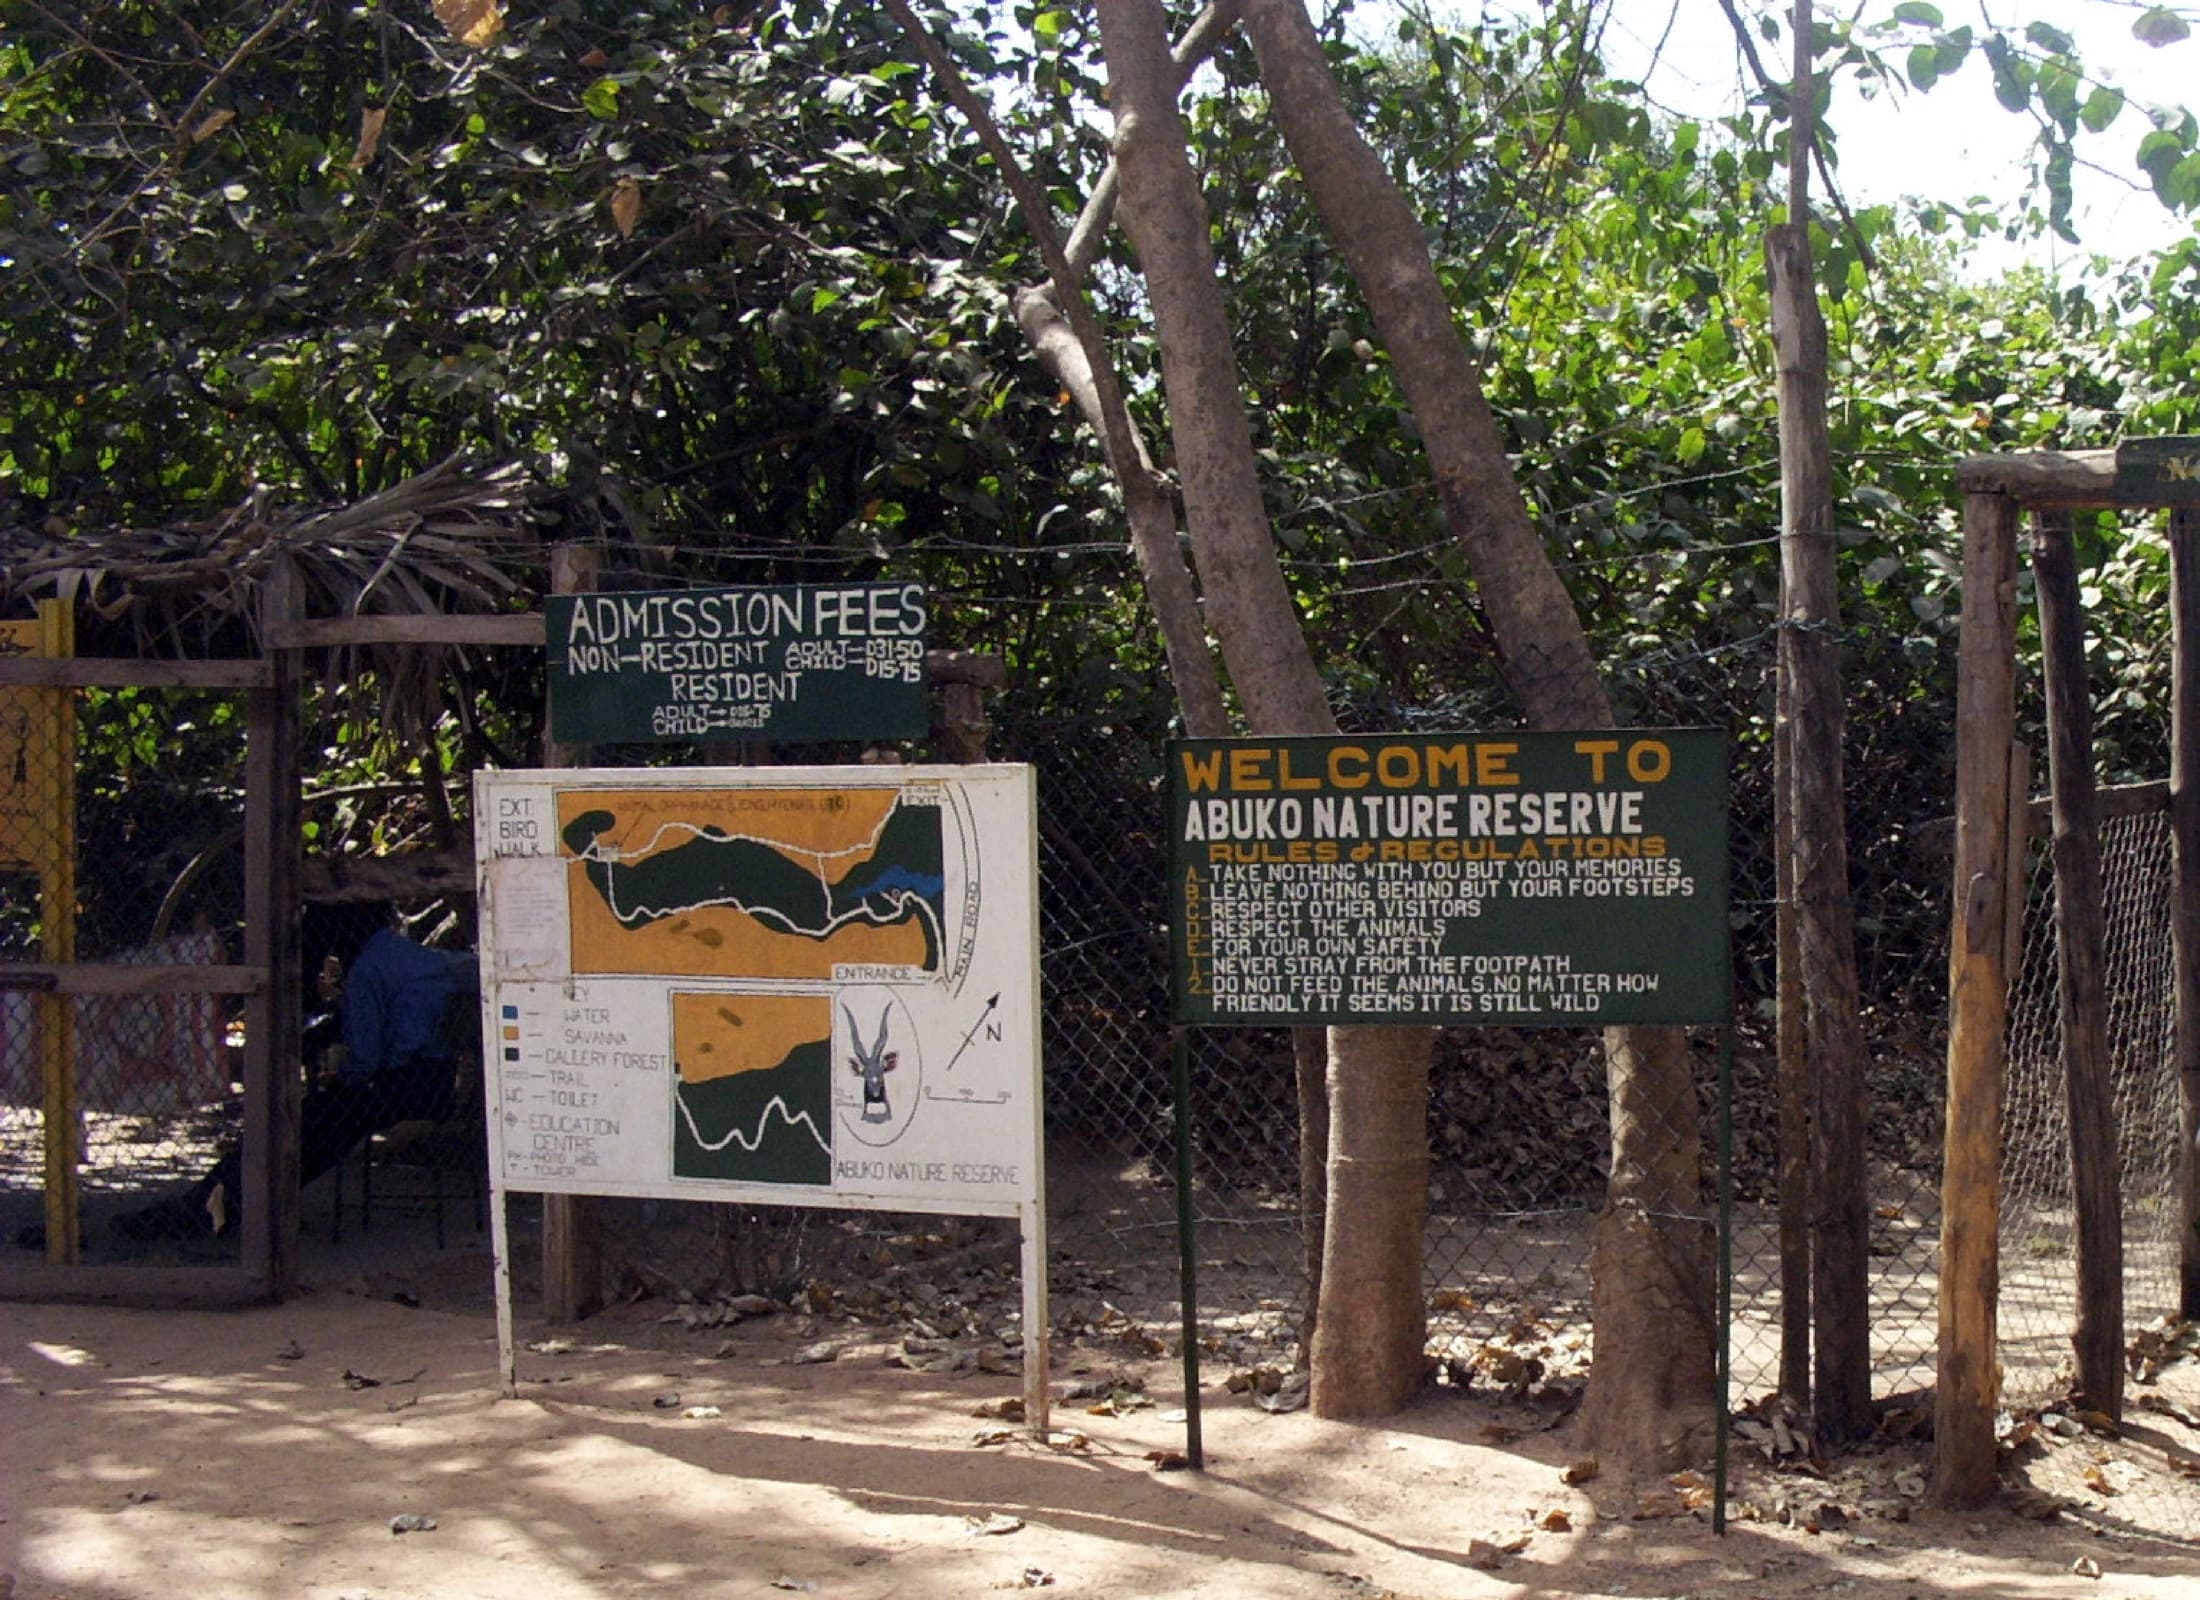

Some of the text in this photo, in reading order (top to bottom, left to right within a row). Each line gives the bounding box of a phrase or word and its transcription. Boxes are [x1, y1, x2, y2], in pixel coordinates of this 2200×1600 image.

[568, 584, 926, 645] ADMISSION FEES
[568, 640, 769, 675] NON-RESIDENT
[784, 640, 848, 657] ADULT
[785, 655, 846, 671] CHILD
[671, 671, 802, 701] RESIDENT
[652, 704, 711, 720] ADULT
[653, 718, 709, 735] CHILD
[1182, 740, 1672, 793] WELCOME TO
[1184, 791, 1644, 841] ABUKO NATURE RESERVE
[499, 820, 539, 839] BIRD
[1209, 841, 1340, 864] RULES
[1380, 834, 1667, 863] REGULATIONS
[1210, 864, 1262, 882] TAKE
[1268, 863, 1356, 882] NOTHING
[1363, 861, 1412, 881] WITH
[1421, 860, 1460, 880] YOU
[1466, 861, 1507, 879] BUT
[1514, 859, 1568, 878] YOUR
[1575, 857, 1682, 877] MEMORIES
[1210, 883, 1275, 900] LEAVE
[1282, 882, 1370, 900] NOTHING
[1377, 881, 1453, 899] BEHIND
[1459, 880, 1500, 898] BUT
[1508, 879, 1563, 898] YOUR
[1569, 876, 1695, 897] FOOTSTEPS
[1210, 901, 1302, 919] RESPECT
[1309, 900, 1376, 918] OTHER
[1384, 899, 1481, 918] VISITORS
[955, 881, 980, 977] MAIN ROAD
[1211, 920, 1302, 938] RESPECT
[1310, 919, 1349, 937] THE
[1356, 918, 1446, 937] ANIMALS
[1211, 939, 1250, 956] FOR
[1258, 939, 1310, 956] YOUR
[1316, 939, 1356, 956] OWN
[1363, 938, 1442, 956] SAFETY
[834, 966, 912, 980] ENTRANCE
[1212, 957, 1278, 975] NEVER
[1284, 957, 1349, 975] STRAY
[1355, 956, 1410, 974] FROM
[1417, 956, 1457, 974] THE
[1460, 955, 1570, 974] FOOTPATH
[1212, 976, 1239, 993] DO
[1244, 976, 1284, 993] NOT
[1290, 976, 1343, 993] FEED
[1351, 975, 1389, 993] THE
[1528, 974, 1610, 992] MATTER
[1617, 973, 1659, 992] HOW
[1212, 994, 1600, 1013] FRIENDLY IT SEEMS IT IS STILL WILD
[563, 1008, 611, 1024] WATER
[986, 1023, 1002, 1042] N
[612, 1054, 667, 1072] FOREST
[550, 1071, 590, 1088] TRAIL
[551, 1092, 598, 1107] TOILET
[528, 1113, 621, 1136] EDUCATION
[533, 1133, 596, 1151] CENTRE
[836, 1161, 1019, 1185] ABUKO NATURE RESERVE
